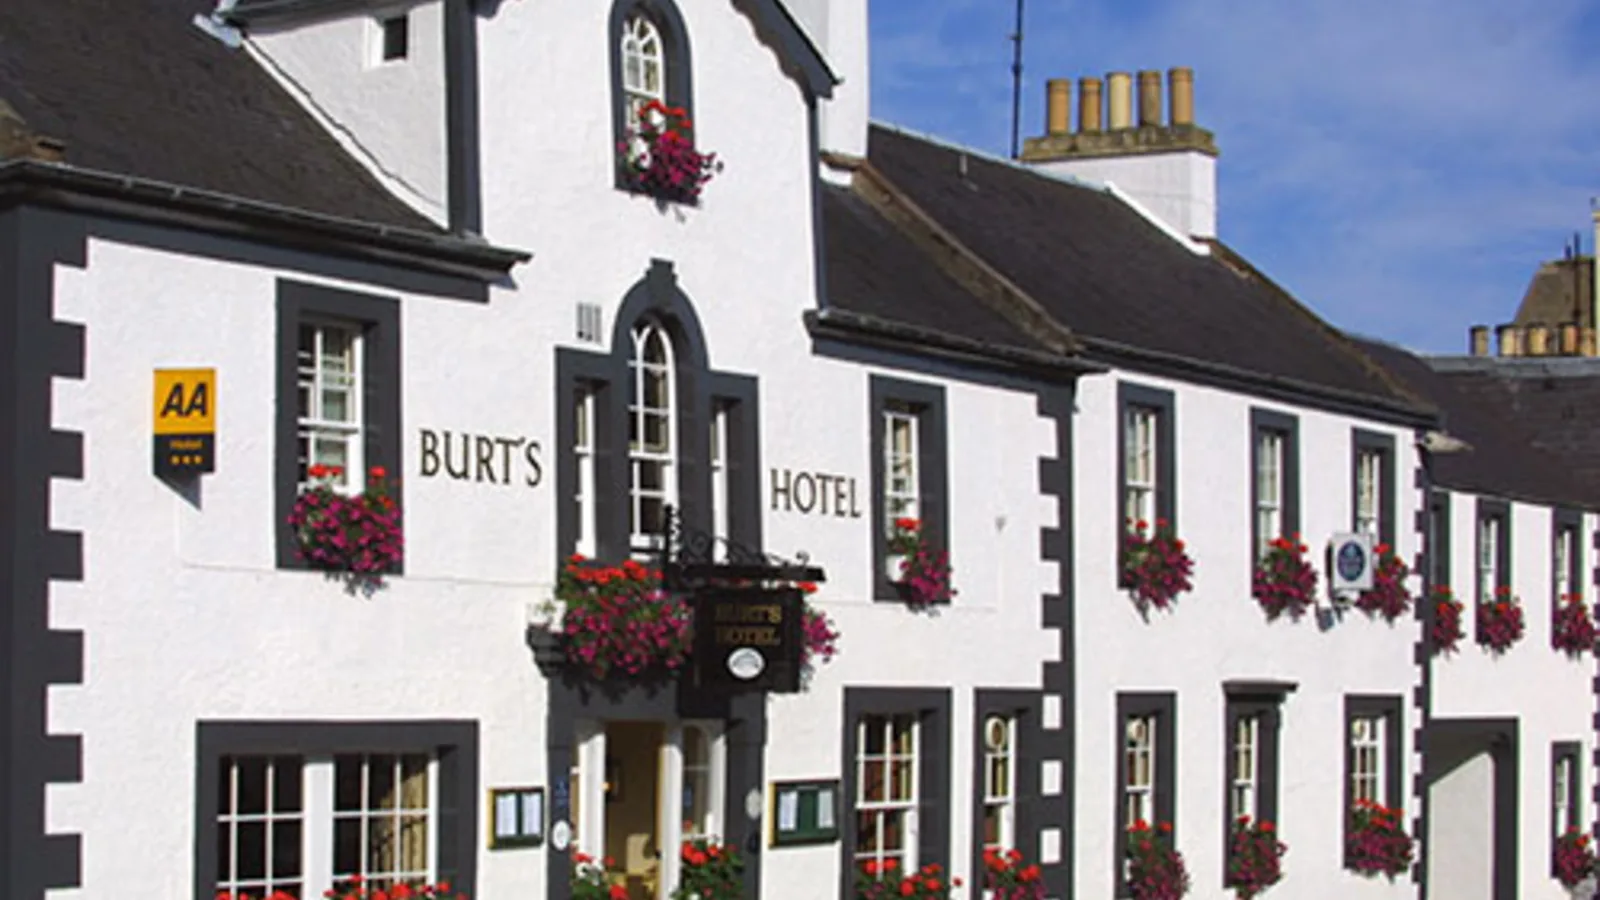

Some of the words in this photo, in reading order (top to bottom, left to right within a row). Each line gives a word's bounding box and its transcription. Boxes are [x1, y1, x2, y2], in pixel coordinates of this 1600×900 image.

[160, 382, 208, 418] AA
[419, 428, 542, 487] BURT'S
[770, 467, 862, 518] HOTEL
